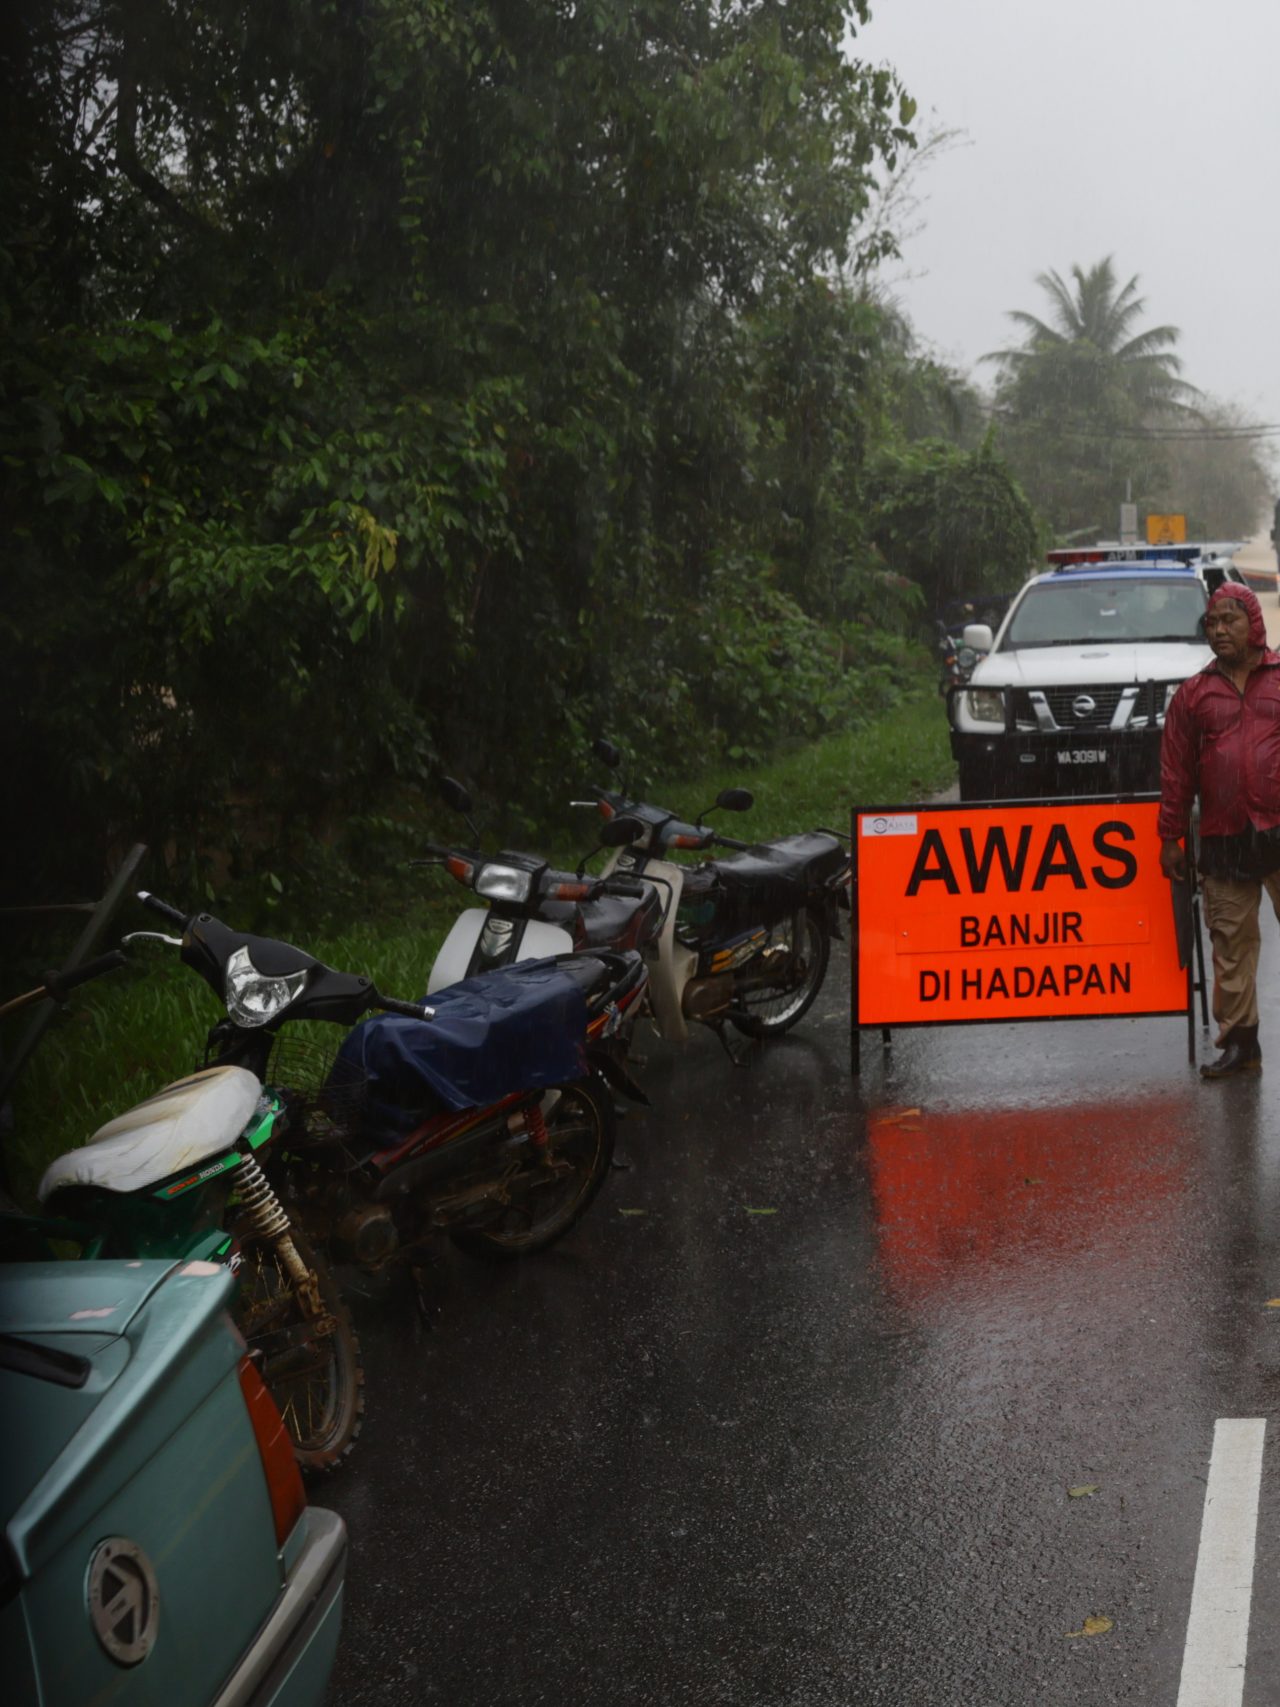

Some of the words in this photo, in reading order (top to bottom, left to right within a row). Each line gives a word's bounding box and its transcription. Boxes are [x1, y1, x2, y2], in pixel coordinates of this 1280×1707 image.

[1107, 551, 1137, 561] APM
[904, 820, 1139, 897] AWAS
[961, 912, 1082, 946] BANJIR
[921, 971, 949, 1001] DI
[963, 963, 1130, 999] HADAPAN
[199, 1163, 225, 1178] HONDA
